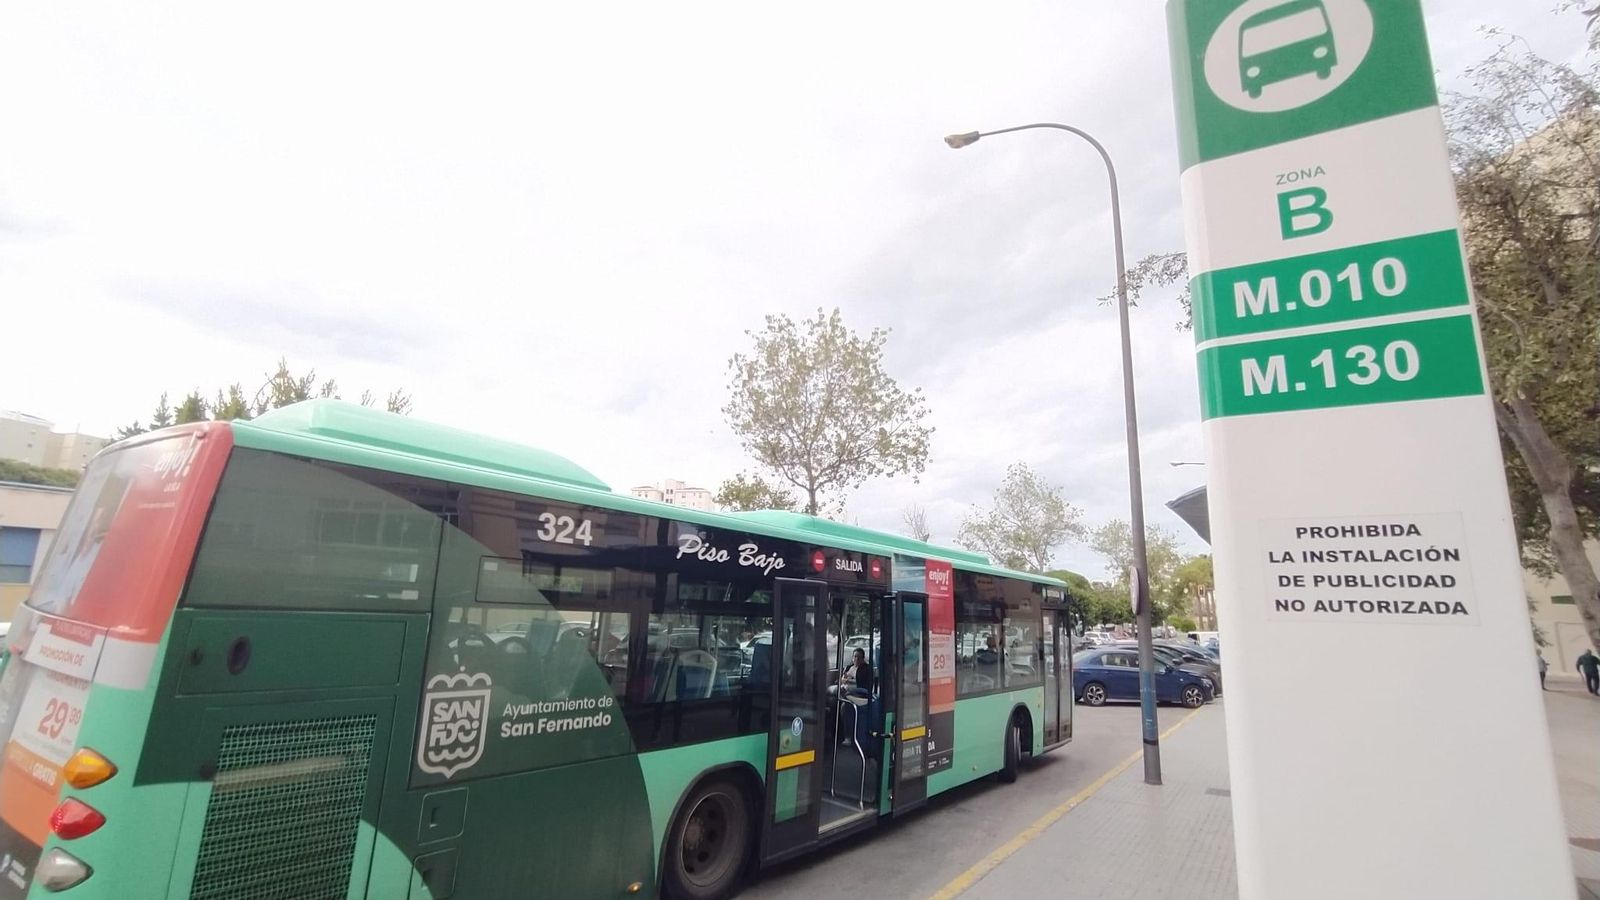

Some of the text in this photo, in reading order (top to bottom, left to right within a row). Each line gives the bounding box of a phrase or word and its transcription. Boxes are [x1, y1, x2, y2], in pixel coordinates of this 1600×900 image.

[1275, 165, 1326, 186] ZONA
[1276, 186, 1334, 240] B
[1233, 258, 1407, 318] M.010
[1241, 340, 1420, 396] M.130
[537, 512, 593, 546] 324
[1295, 524, 1422, 539] PROHIBIDA
[676, 534, 786, 576] Piso Bajo
[835, 558, 863, 573] SALIDA
[1268, 546, 1461, 563] LA INSTALACIÓN
[928, 568, 950, 586] enjoy!
[1278, 575, 1457, 588] DE PUBLICIDAD
[1275, 599, 1470, 616] NO AUTORIZADA
[74, 654, 85, 667] DE
[432, 700, 481, 723] SAN
[502, 695, 613, 720] Ayuntamiento de
[500, 712, 612, 738] San Fernando
